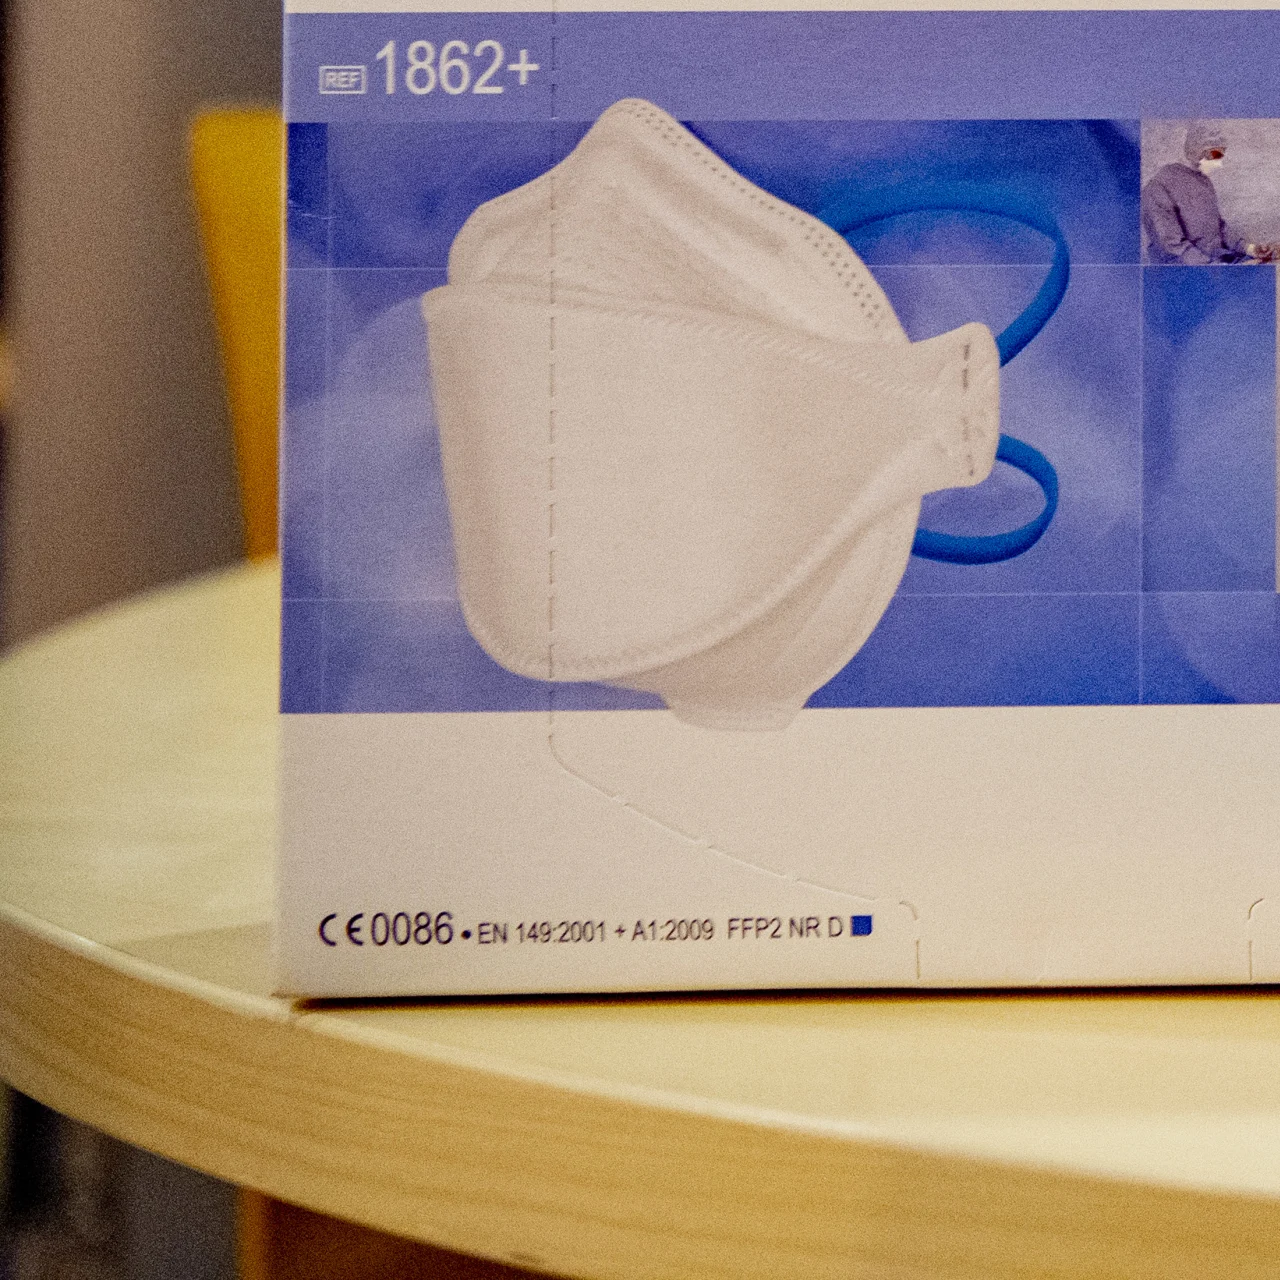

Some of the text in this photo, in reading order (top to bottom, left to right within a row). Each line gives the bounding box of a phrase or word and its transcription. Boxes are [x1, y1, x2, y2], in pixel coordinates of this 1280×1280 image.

[323, 39, 540, 96] REF 1862+
[477, 921, 508, 945] EN
[515, 920, 606, 944] 149:2001
[631, 918, 715, 942] A1:2009
[727, 917, 783, 939] FFP2
[788, 915, 821, 938] NR
[827, 915, 844, 937] D
